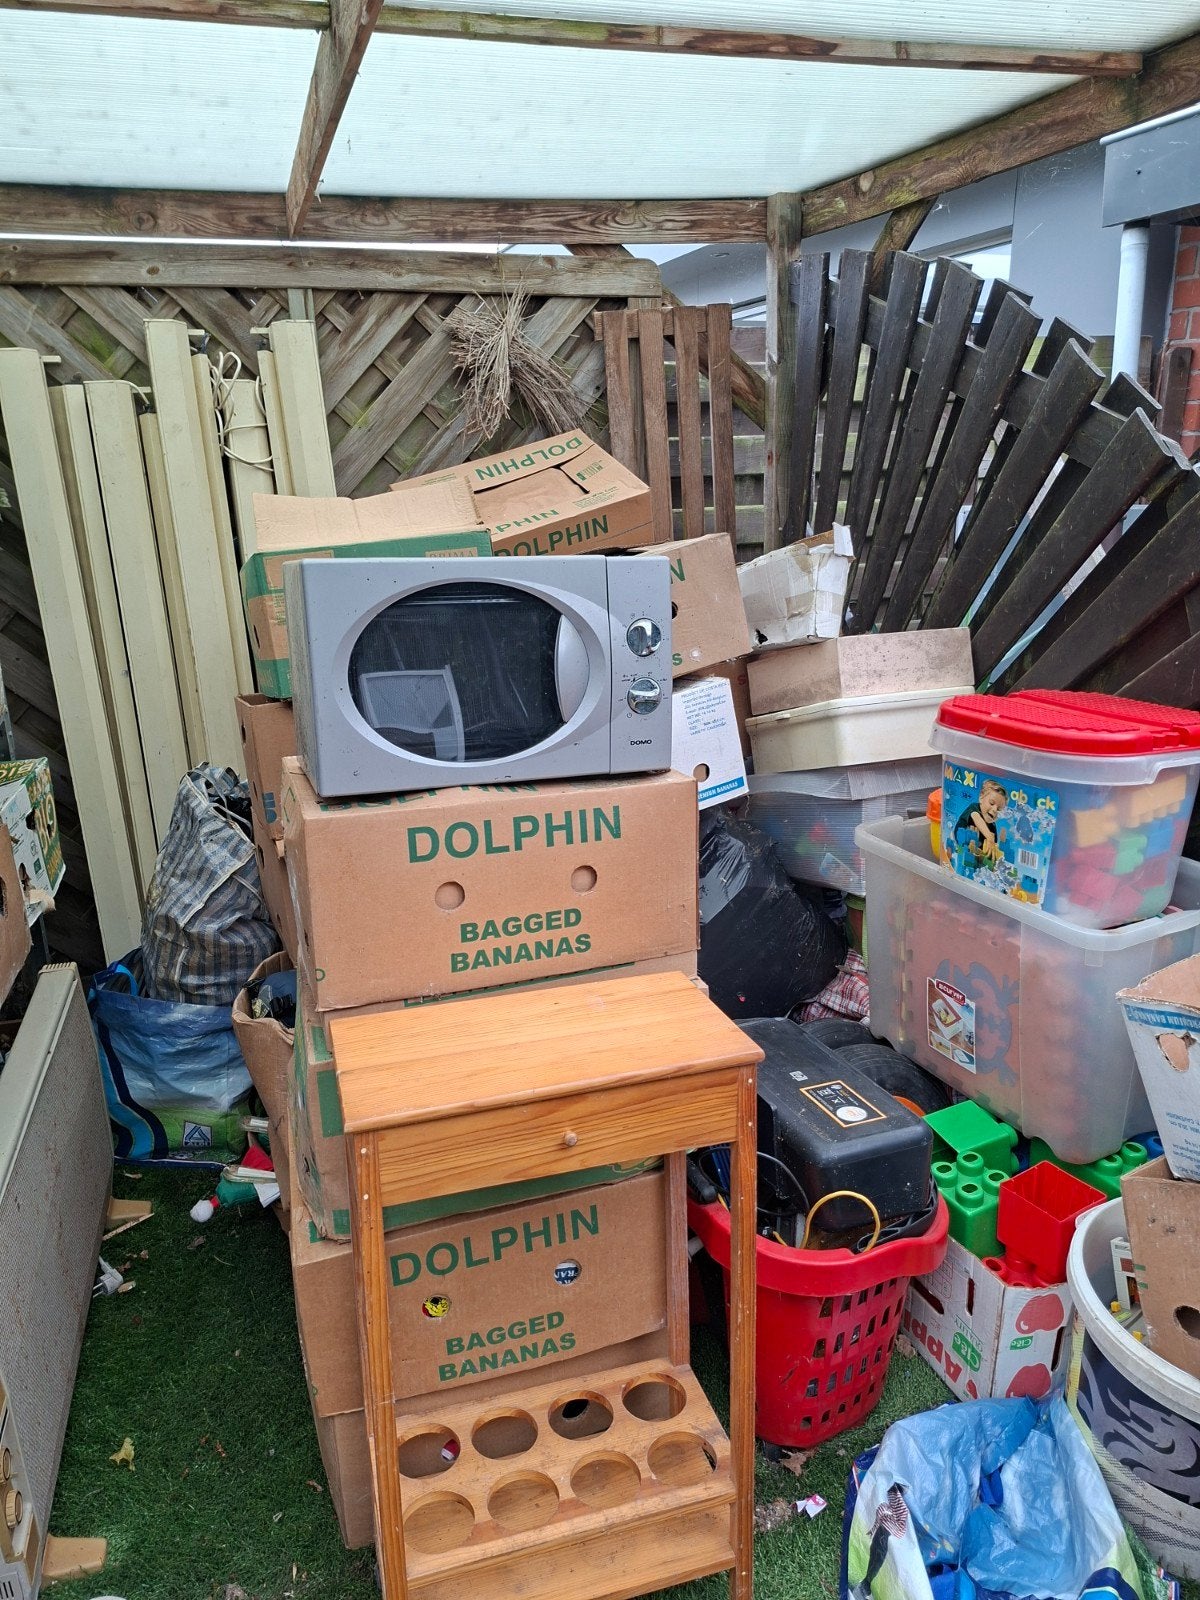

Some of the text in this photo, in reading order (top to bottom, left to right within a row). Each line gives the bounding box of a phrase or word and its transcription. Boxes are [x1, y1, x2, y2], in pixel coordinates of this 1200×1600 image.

[474, 436, 583, 481] DOLPHIN
[494, 509, 559, 533] PHIN
[944, 764, 978, 789] MAXI
[406, 805, 622, 864] DOLPHIN
[460, 907, 582, 943] BAGGED
[450, 933, 592, 973] BANANAS
[389, 1204, 601, 1288] DOLPHIN
[446, 1310, 565, 1357] BAGGED
[438, 1331, 576, 1383] BANANAS
